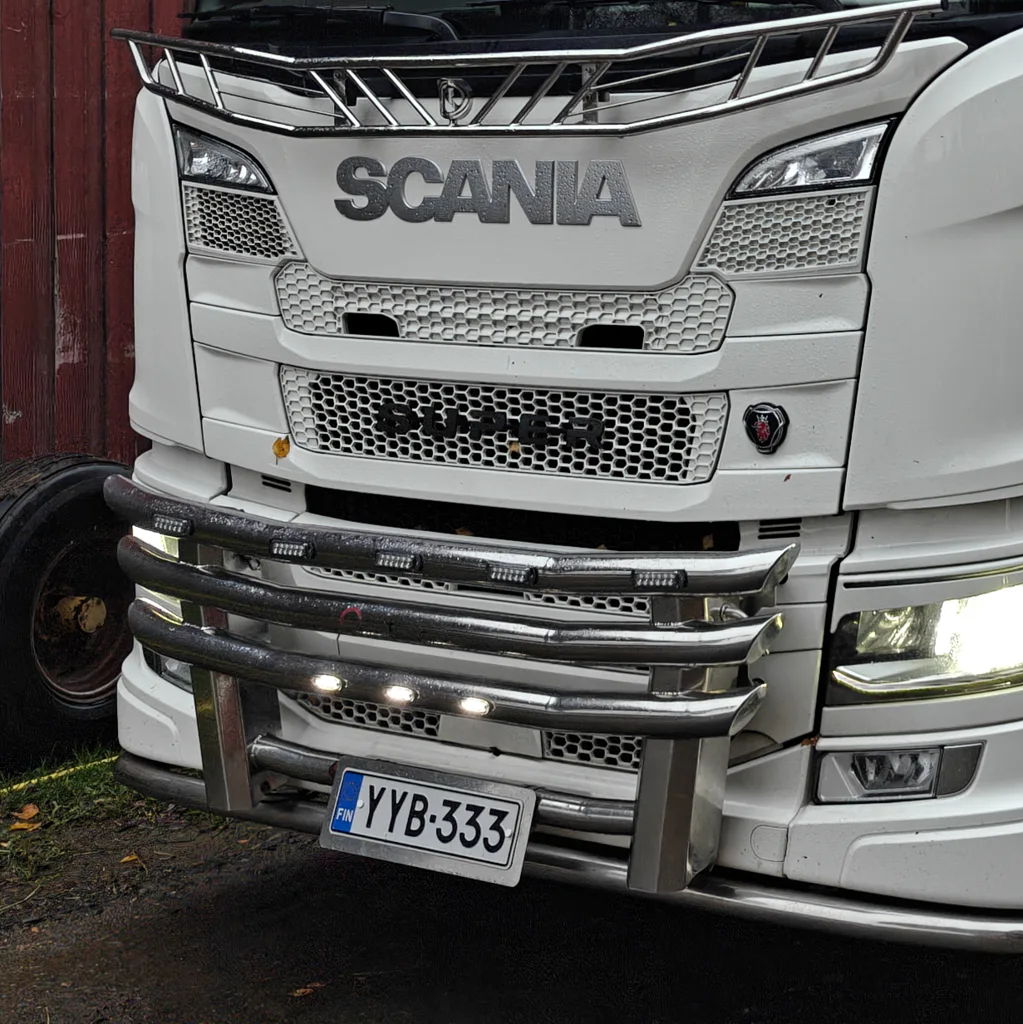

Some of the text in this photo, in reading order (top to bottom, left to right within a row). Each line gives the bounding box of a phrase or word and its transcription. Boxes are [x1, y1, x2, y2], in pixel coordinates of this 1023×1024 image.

[334, 156, 642, 228] SCANIA
[376, 402, 604, 451] SUPER
[335, 807, 354, 823] FIN
